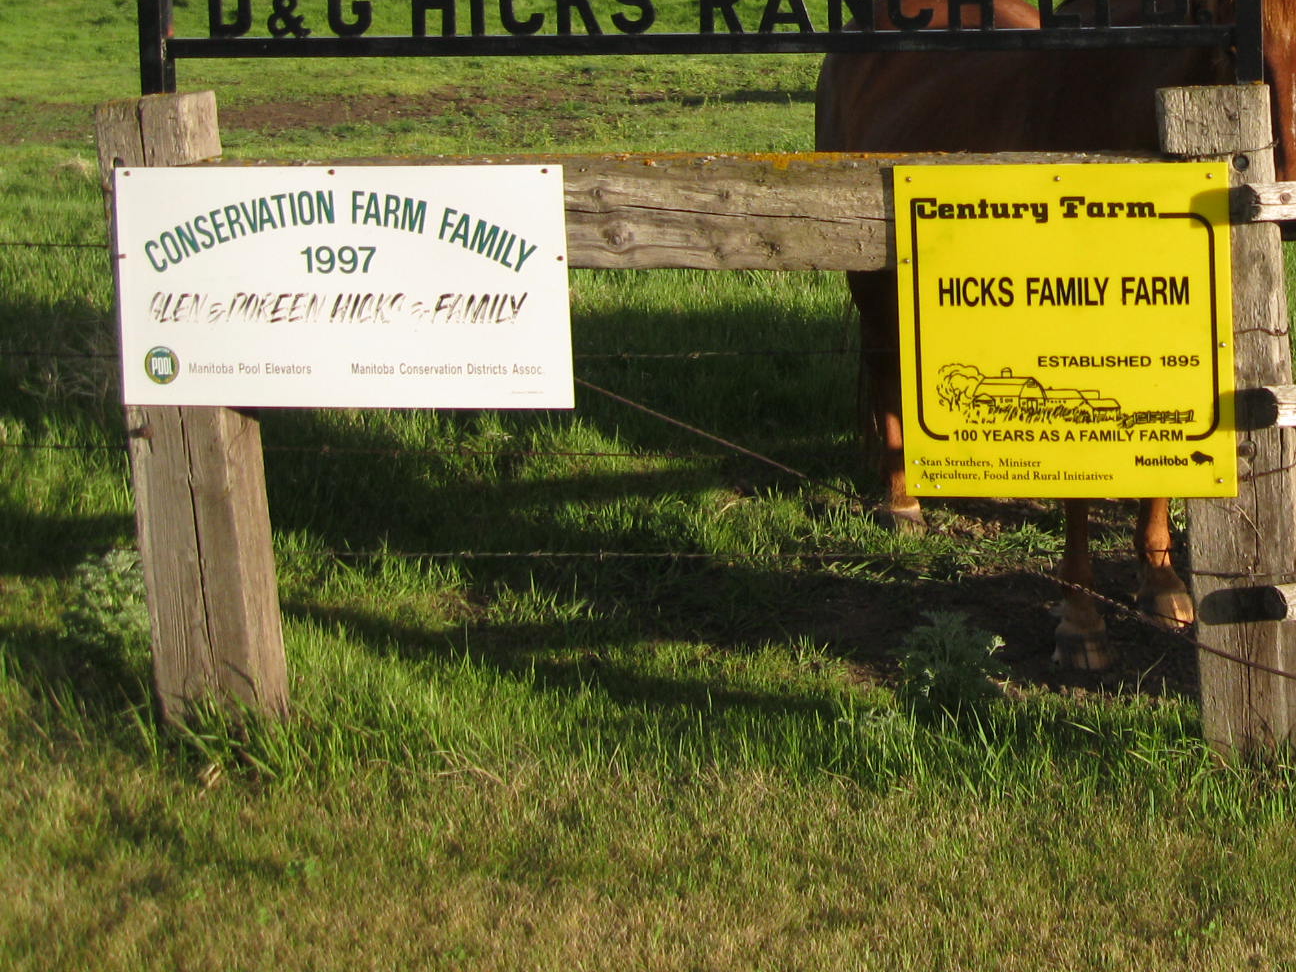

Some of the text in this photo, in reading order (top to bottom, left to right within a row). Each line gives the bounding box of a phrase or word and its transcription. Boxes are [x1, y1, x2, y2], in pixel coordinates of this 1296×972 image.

[916, 196, 1158, 223] Century Farm
[144, 190, 538, 274] CONSERVATION FARM FAMILY
[300, 245, 377, 274] 1997
[938, 275, 1191, 307] HICKS FAMILY FARM
[149, 291, 206, 323] GLEN
[227, 292, 326, 323] DOREEN
[431, 291, 528, 323] FAMILY
[151, 357, 174, 375] POOL
[188, 362, 312, 375] Manitoba Pool Elevators
[350, 362, 395, 375] Manitoba
[399, 362, 463, 375] Conservation
[466, 362, 508, 375] Districts
[1037, 354, 1201, 369] ESTABLISHED 1895
[952, 429, 1184, 442] 100 YEARS AS A FAMILY FARM
[919, 456, 1042, 469] Stan Struthers, Minister
[1134, 454, 1189, 467] Manitoba
[920, 469, 1114, 483] Agriculture, Food and Rural Initiatives
